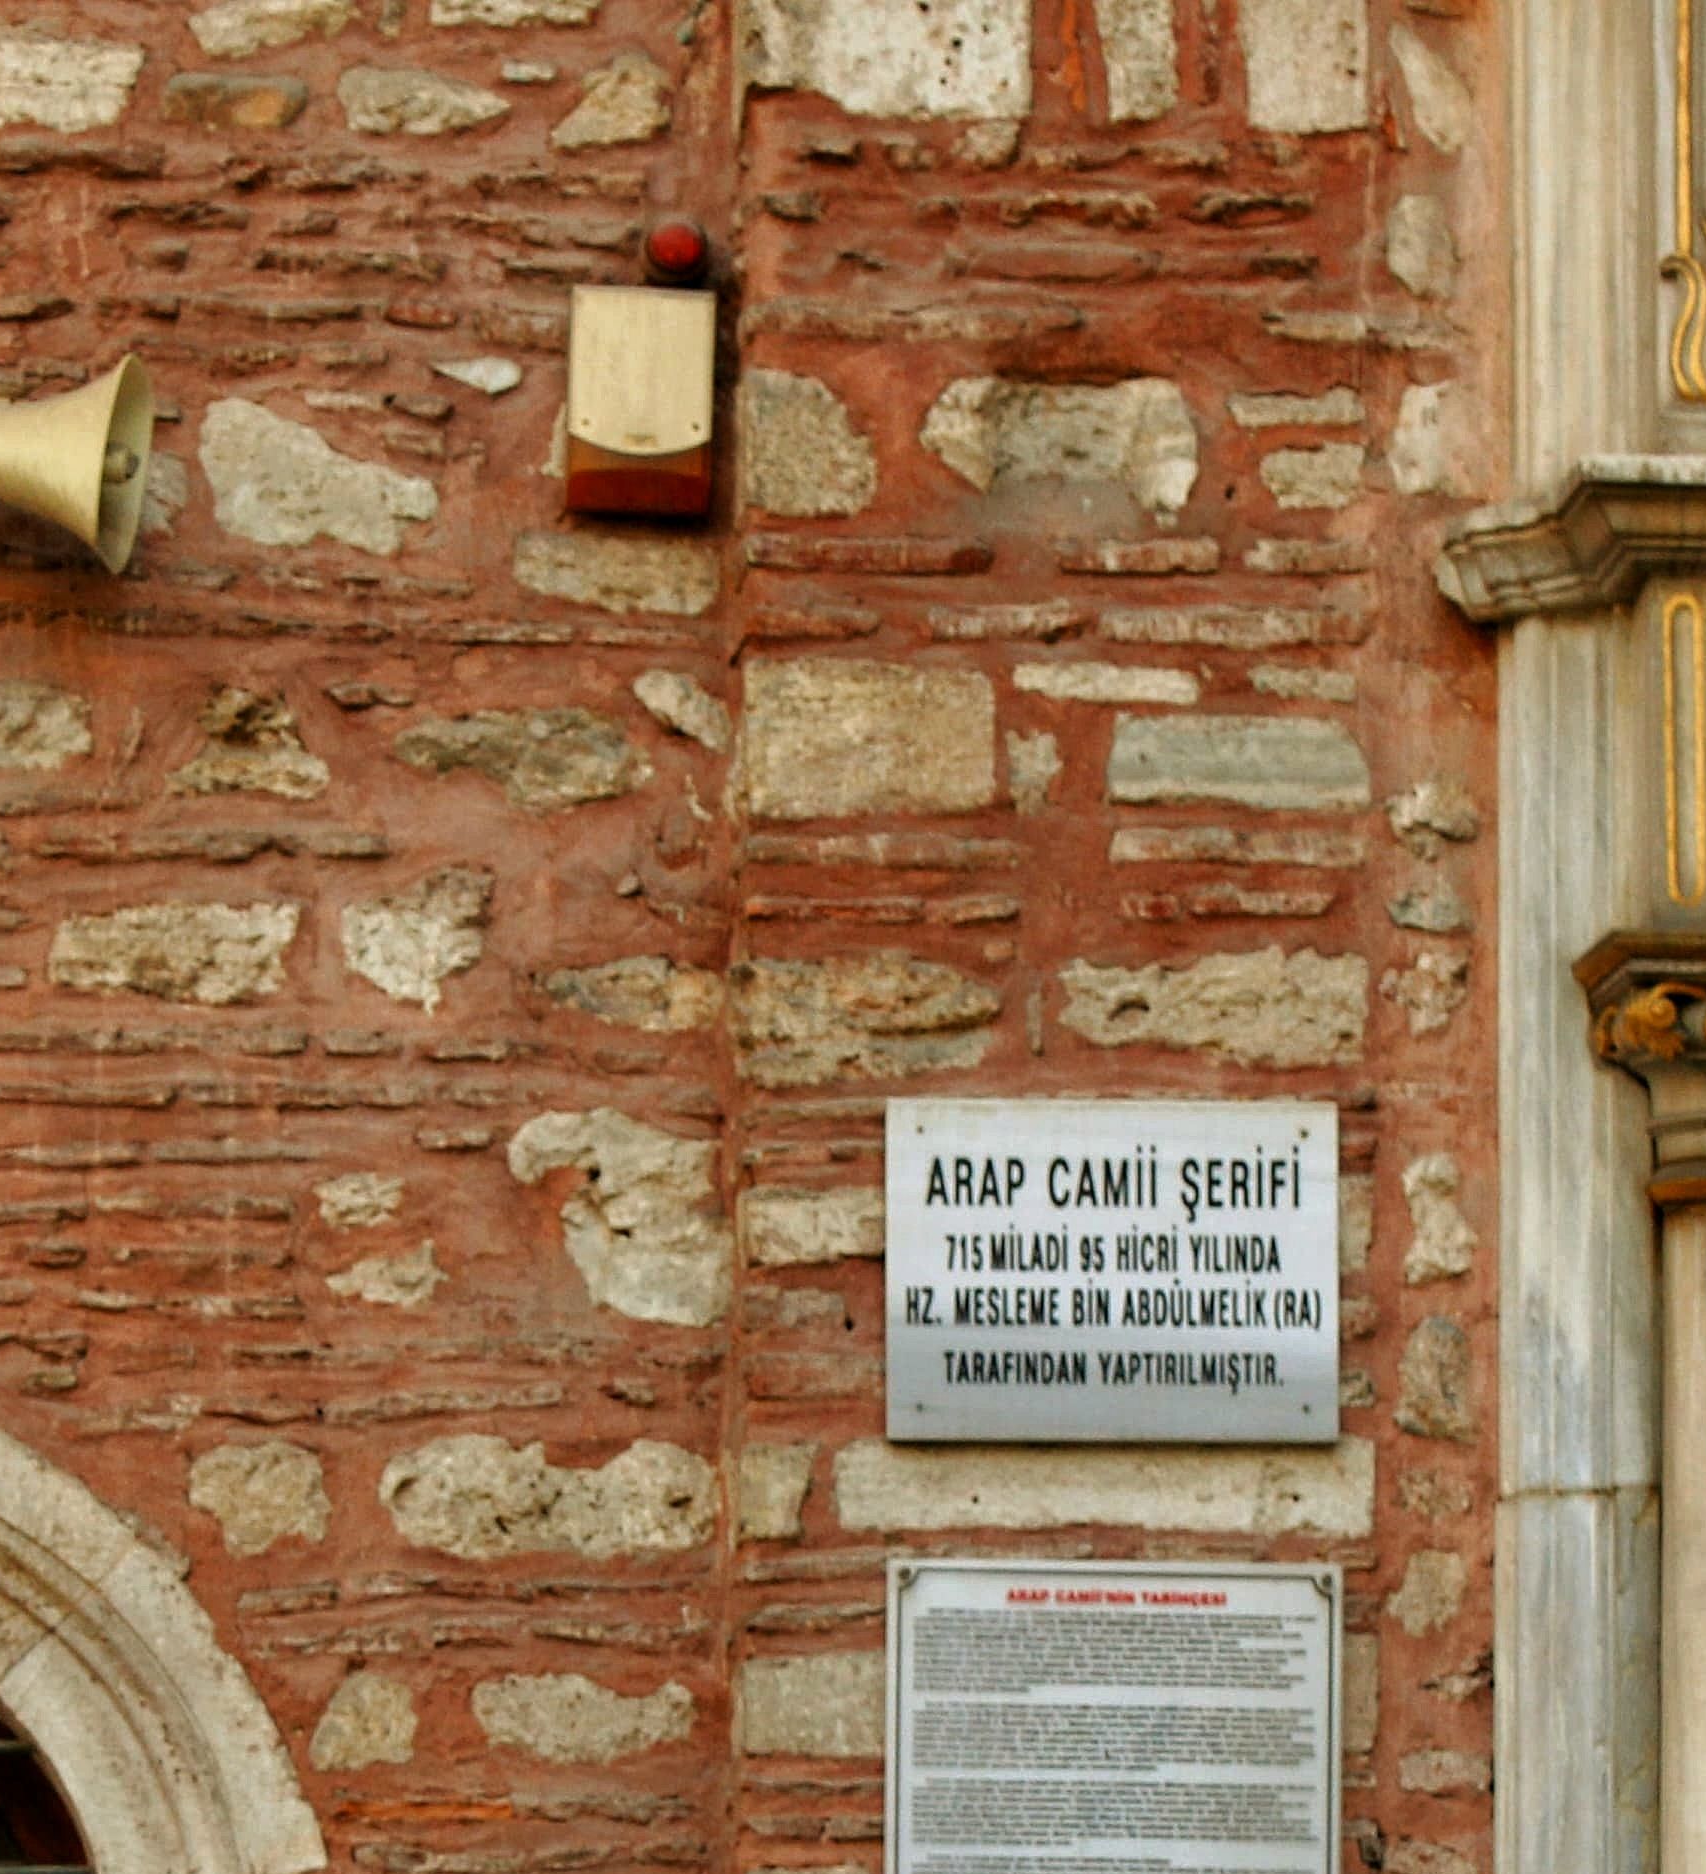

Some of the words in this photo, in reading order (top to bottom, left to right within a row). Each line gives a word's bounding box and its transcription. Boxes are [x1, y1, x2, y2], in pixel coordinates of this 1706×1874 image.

[925, 1157, 1027, 1208] ARAP
[1048, 1145, 1159, 1209] CAMİİ
[1181, 1145, 1302, 1222] ŞERİFİ
[945, 1234, 983, 1272] 715
[993, 1223, 1068, 1272] MİLADİ
[1079, 1235, 1105, 1272] 95
[1116, 1224, 1179, 1272] HİCRİ
[1191, 1234, 1282, 1273] YILINDA
[906, 1287, 942, 1326] HZ.
[954, 1287, 1060, 1327] MESLEME
[1071, 1278, 1111, 1327] BİN
[1122, 1278, 1267, 1328] ABDÜLMELİK
[1273, 1289, 1323, 1330] (RA)
[944, 1351, 1088, 1385] TARAFINDAN
[1098, 1353, 1285, 1394] YAPTIRILMIŞTIR.
